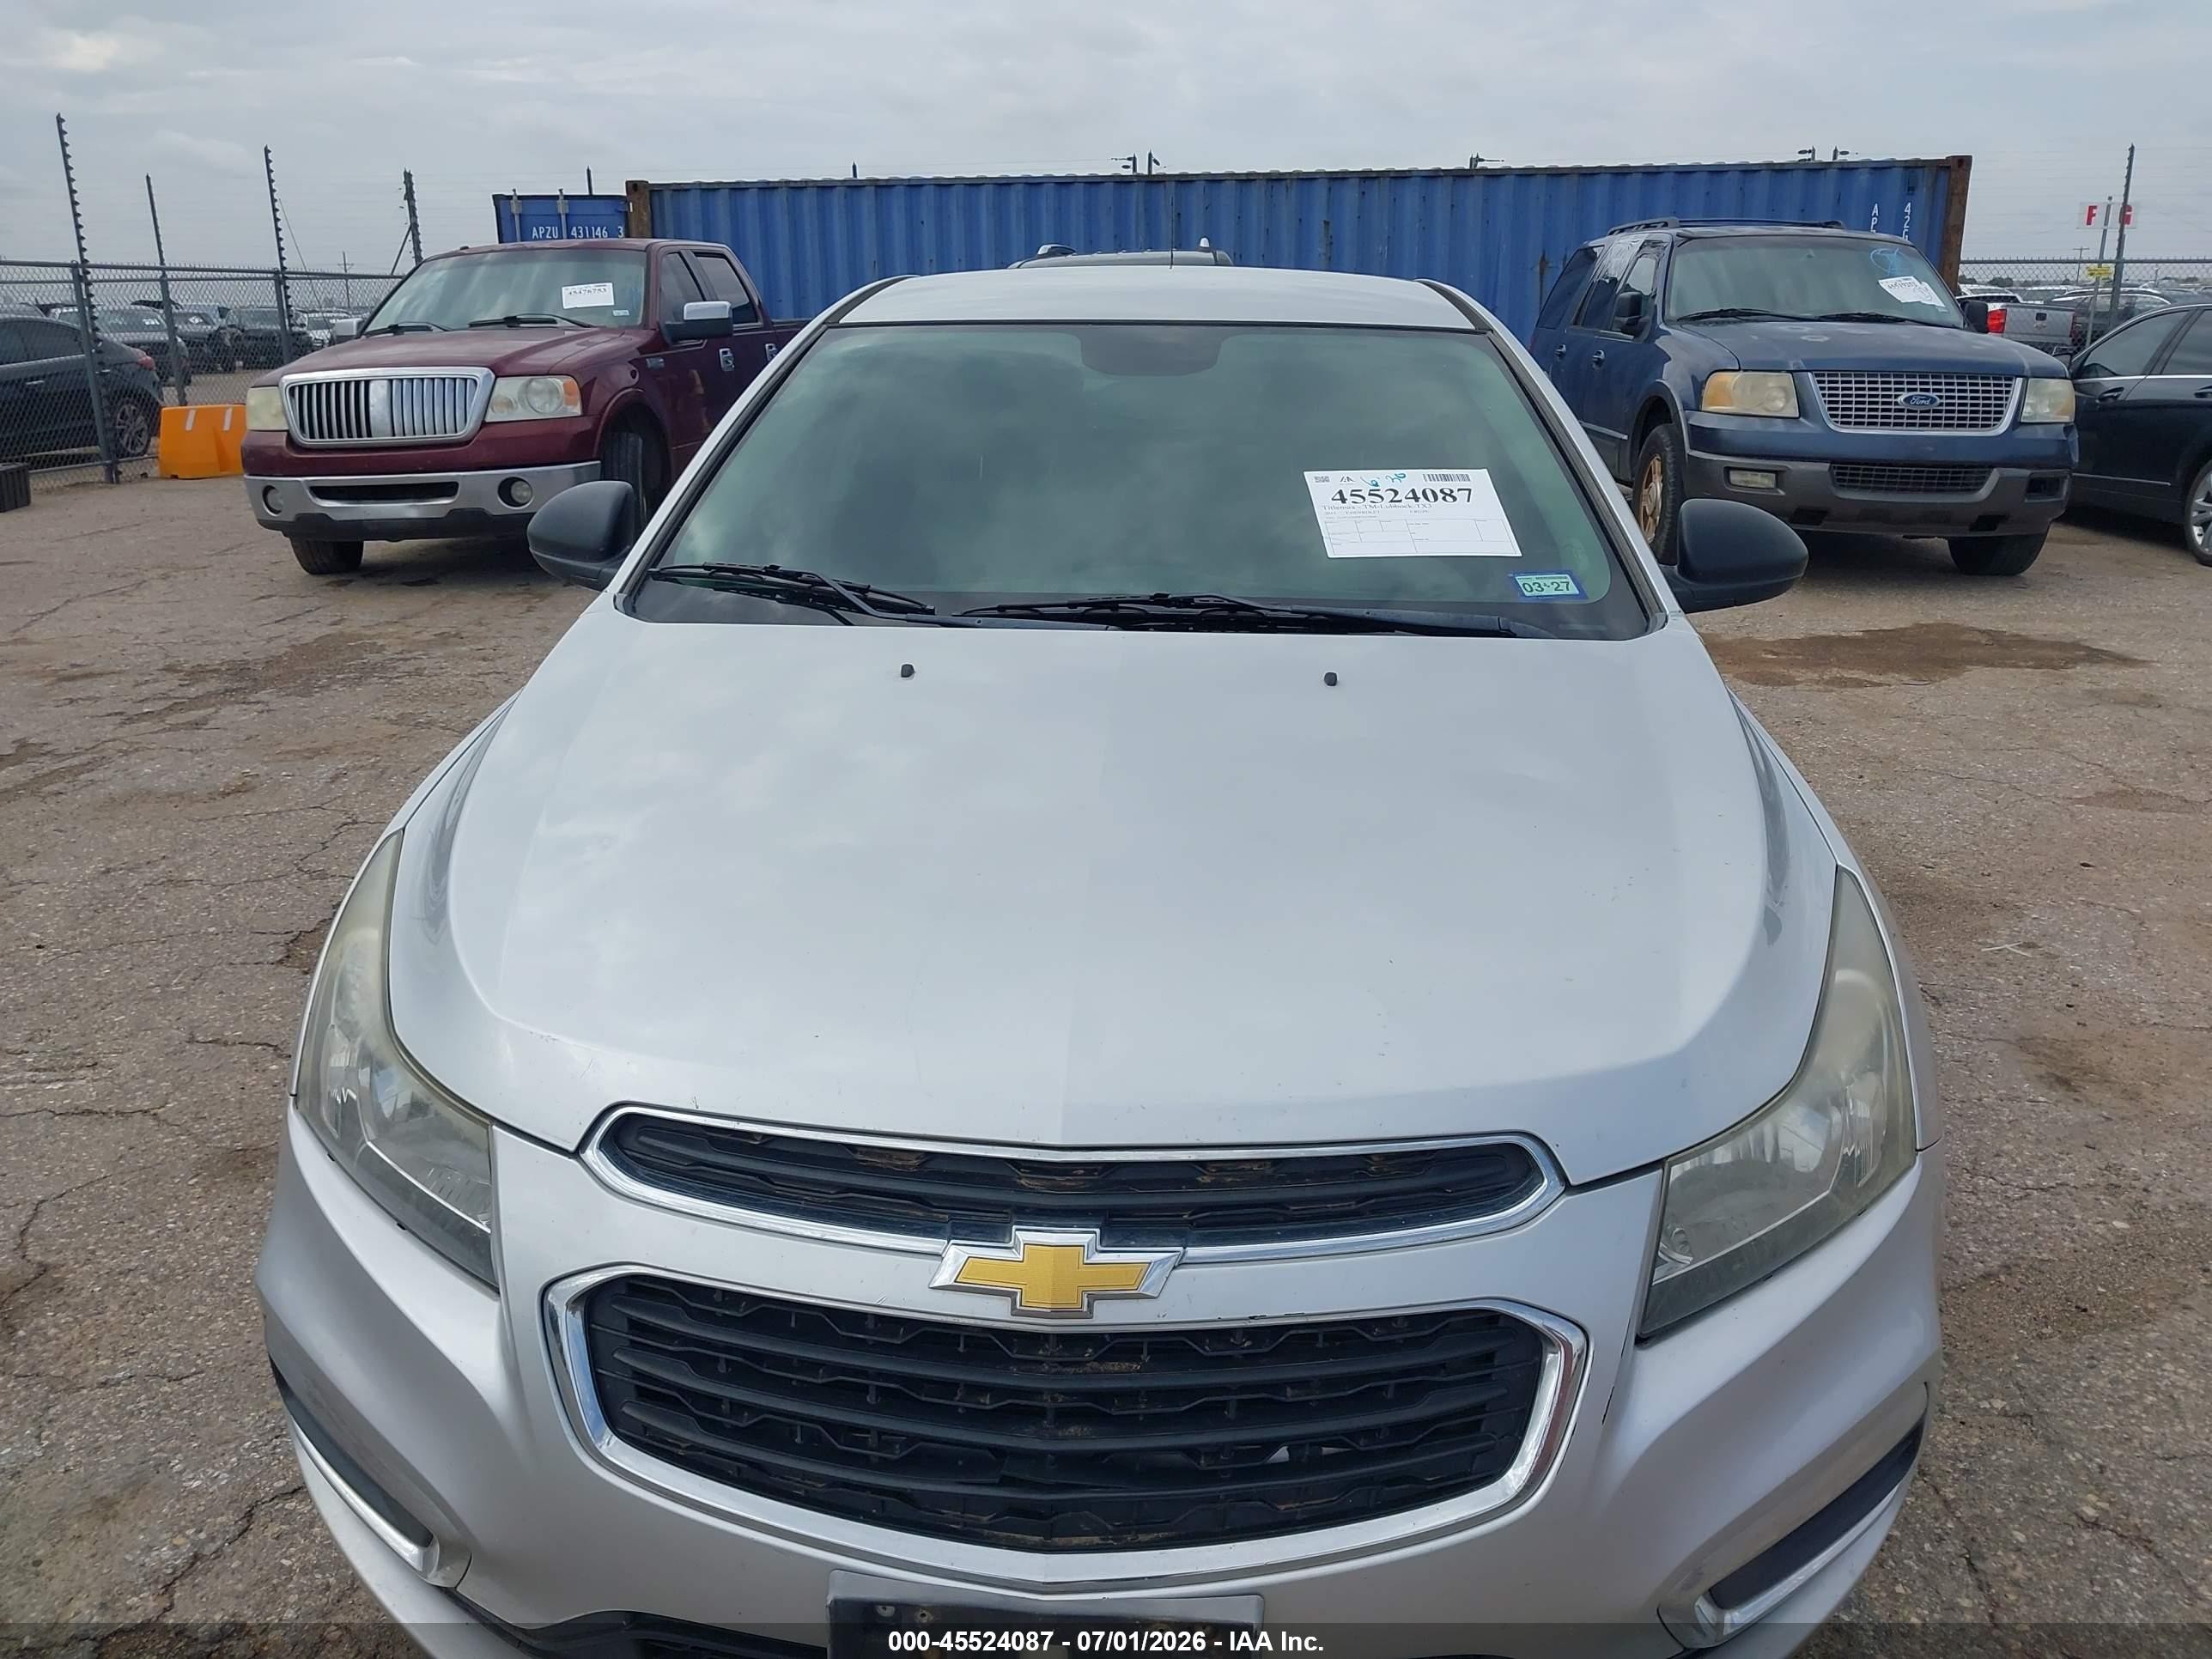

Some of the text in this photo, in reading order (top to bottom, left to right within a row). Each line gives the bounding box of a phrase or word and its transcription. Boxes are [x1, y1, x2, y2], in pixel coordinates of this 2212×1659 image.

[1870, 204, 1879, 233] AP
[2086, 205, 2098, 226] F
[532, 226, 624, 239] APZU 431146 3
[1910, 395, 1931, 405] Ford
[1331, 487, 1473, 504] 45524087
